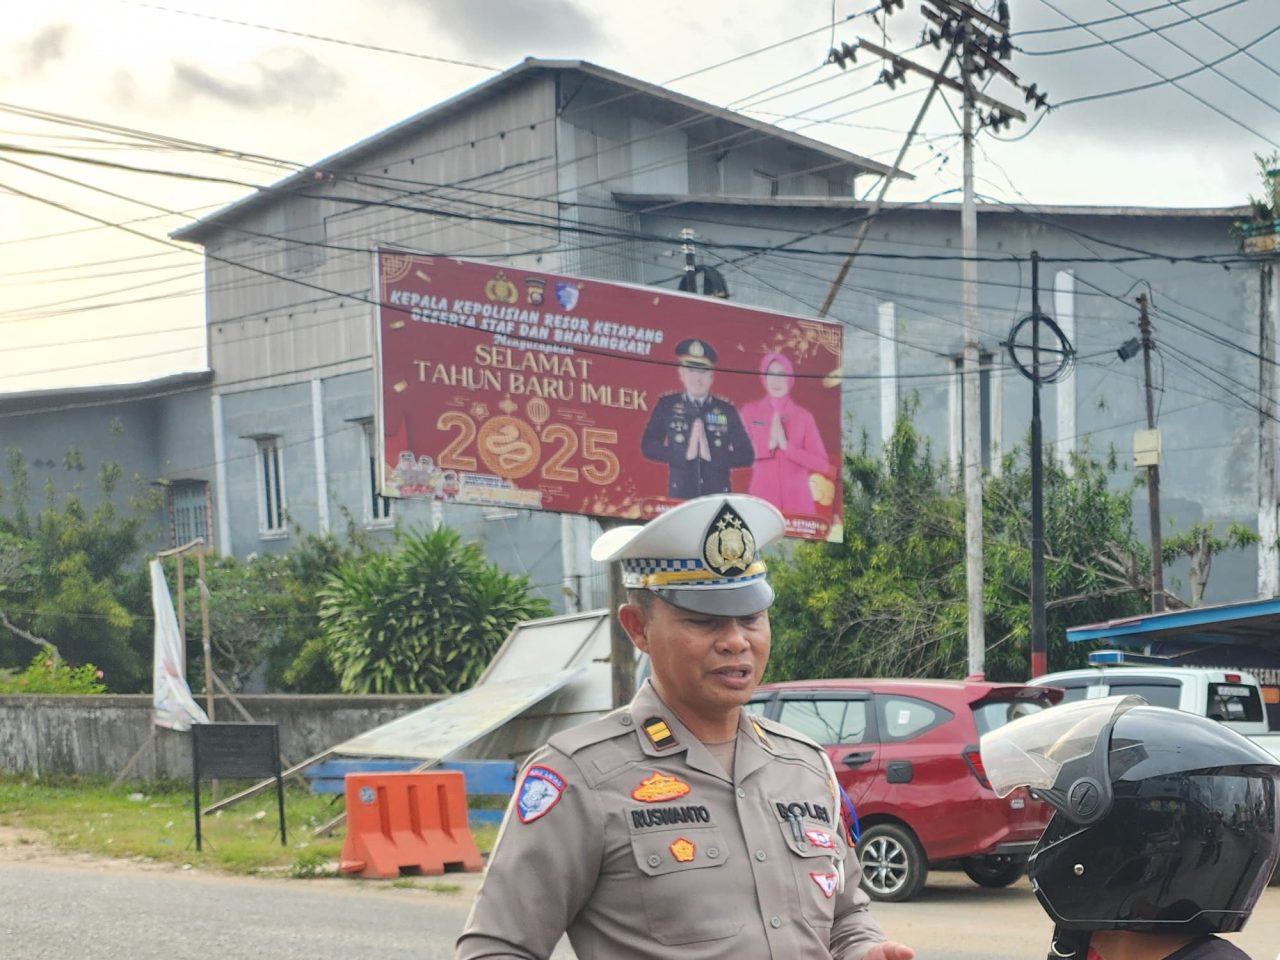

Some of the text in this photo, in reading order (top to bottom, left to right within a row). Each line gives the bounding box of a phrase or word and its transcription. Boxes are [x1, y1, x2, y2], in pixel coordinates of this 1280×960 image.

[390, 290, 664, 344] KEPALA KEPOLISIAN RESOR KETAPANG
[480, 318, 515, 335] STAF
[520, 324, 549, 340] DAN
[554, 329, 652, 355] BHAYANGKARI
[475, 344, 592, 380] SELAMAT
[413, 360, 648, 411] TAHUN BARU IMLEK
[631, 805, 711, 828] RUSWANTO
